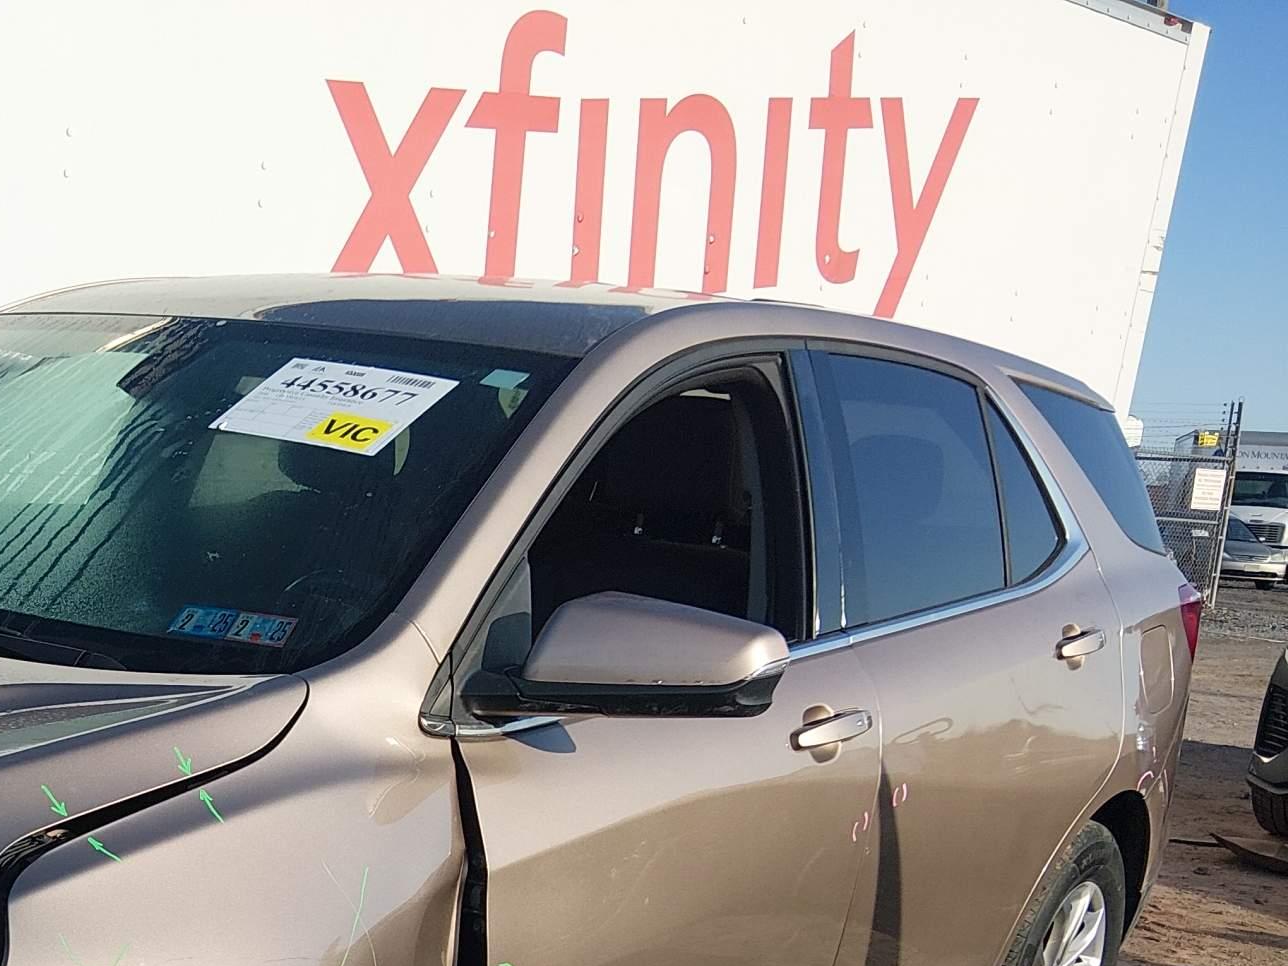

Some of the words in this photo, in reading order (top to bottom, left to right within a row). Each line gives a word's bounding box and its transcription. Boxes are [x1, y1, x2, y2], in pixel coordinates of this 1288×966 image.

[324, 8, 980, 319] xfinity
[279, 375, 420, 407] 44558677
[323, 418, 380, 442] VIC
[178, 613, 194, 630] 2
[234, 619, 250, 637] 2
